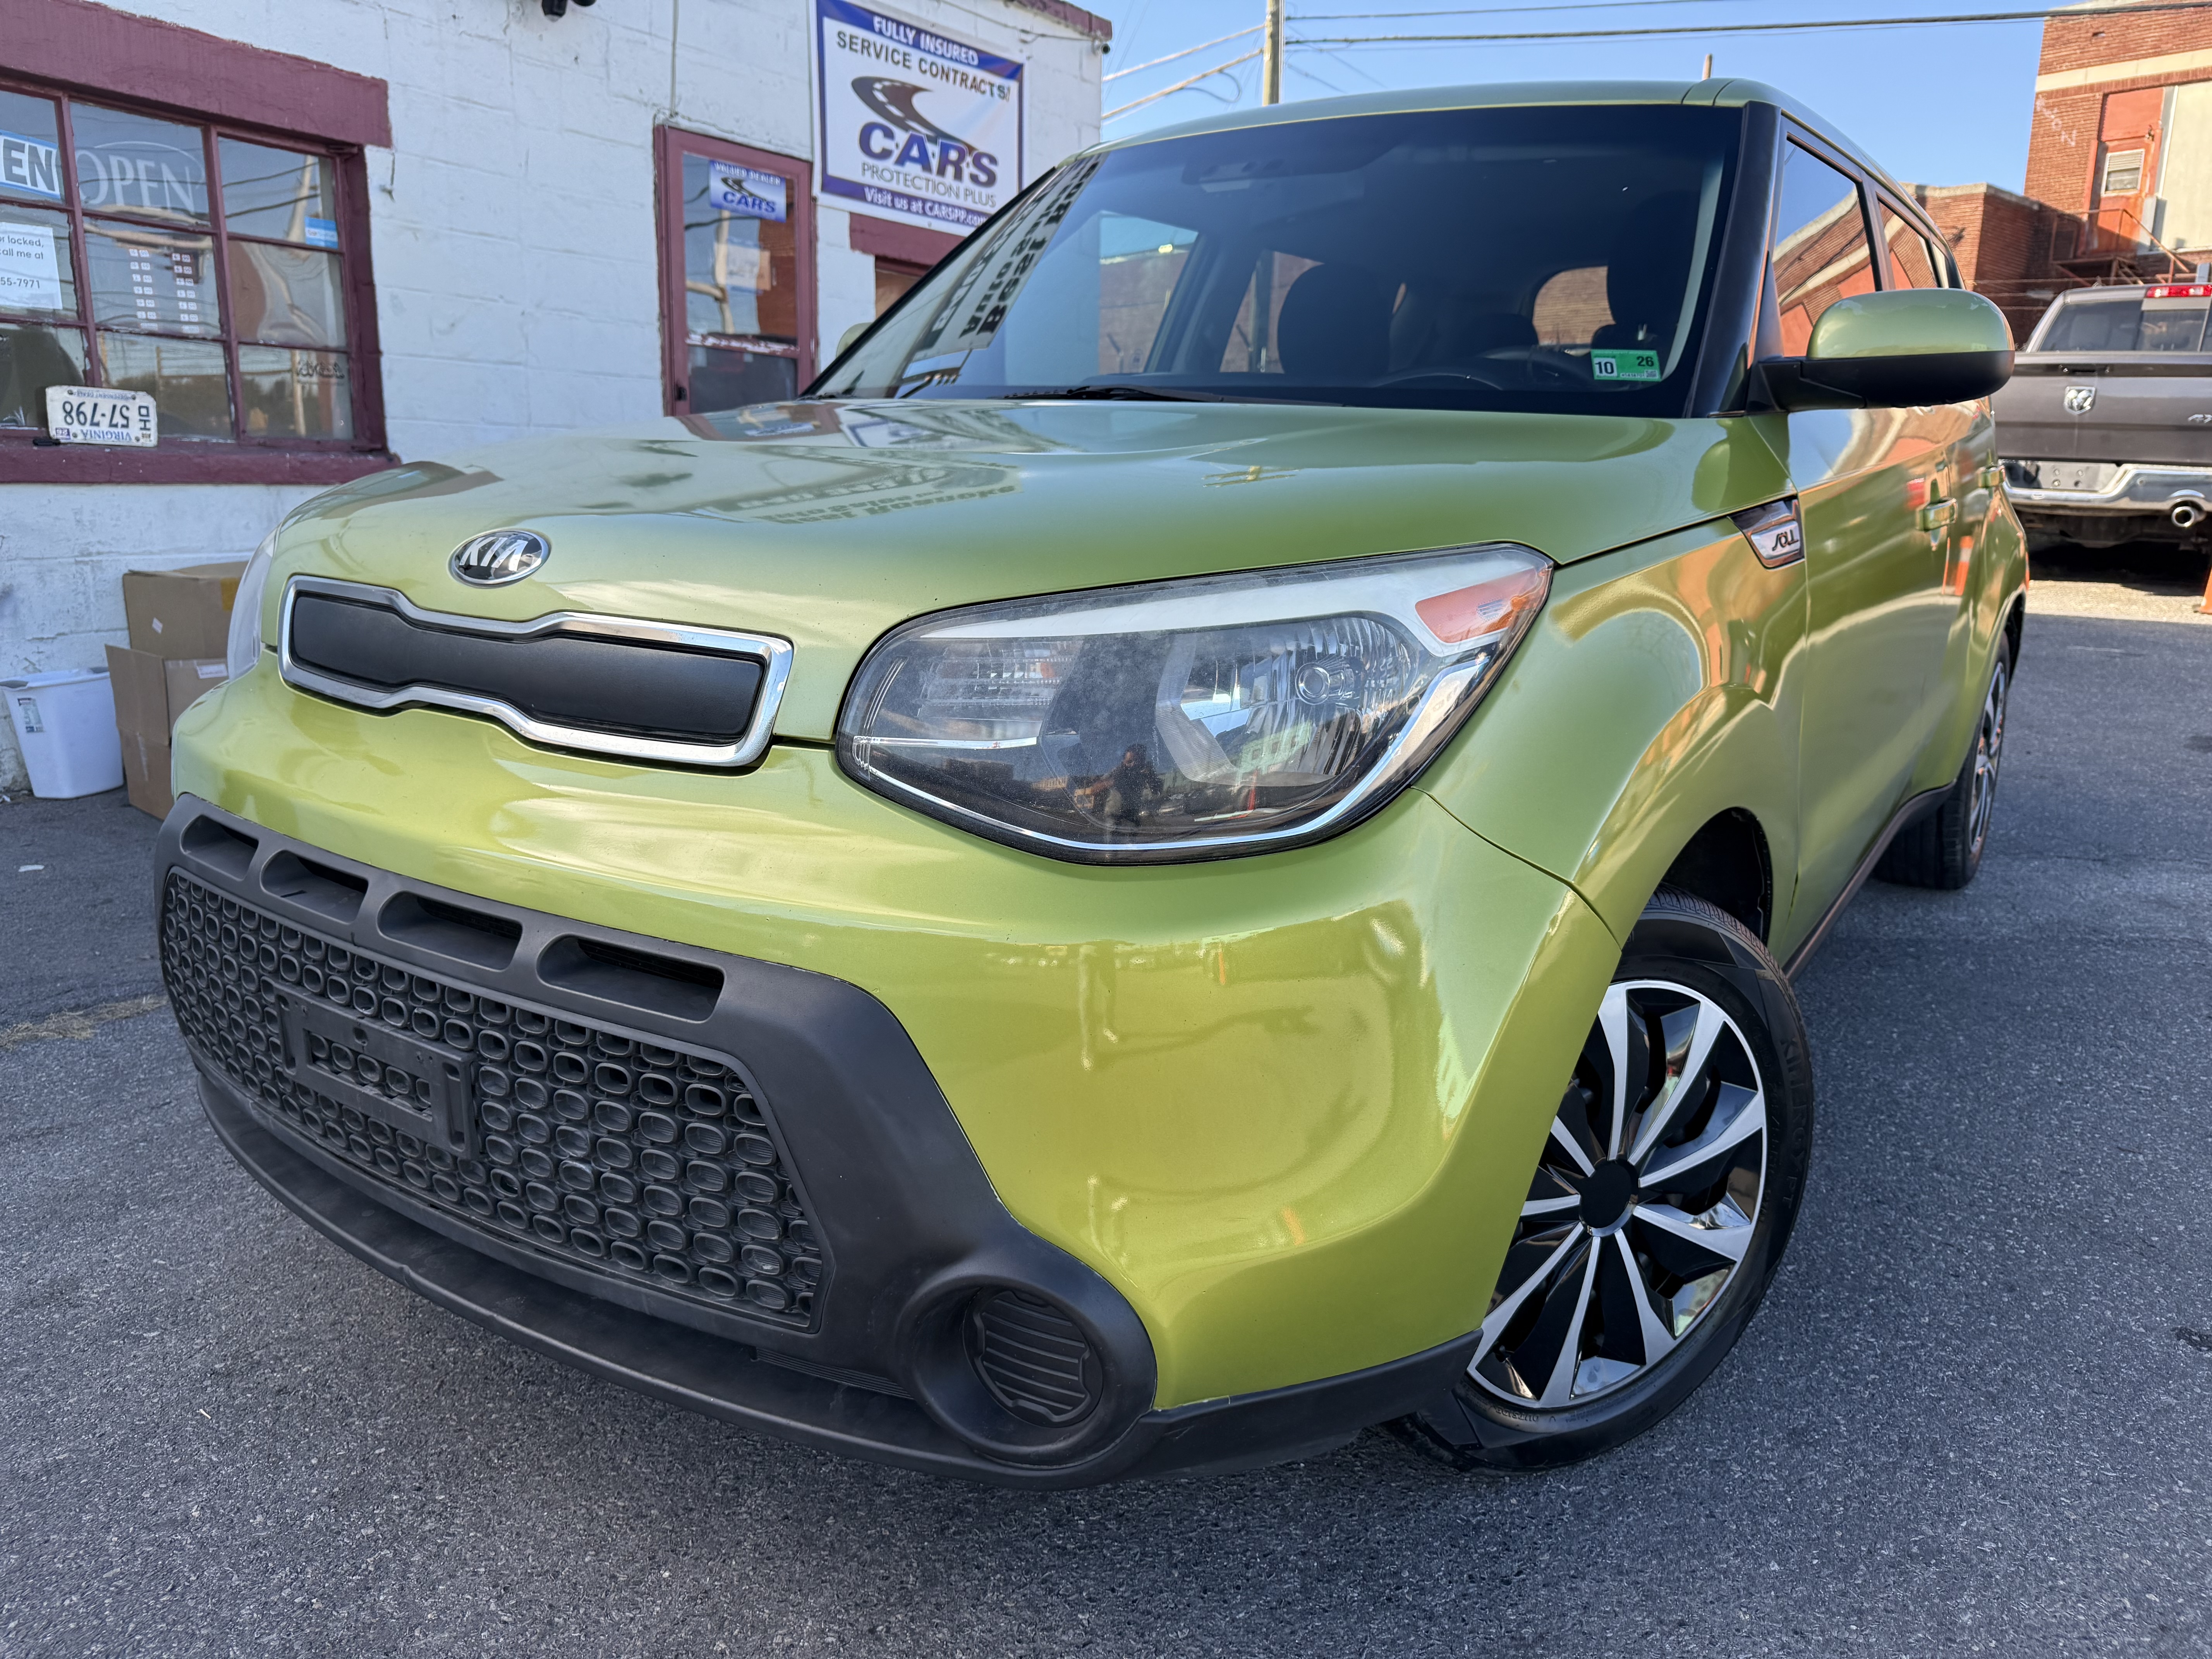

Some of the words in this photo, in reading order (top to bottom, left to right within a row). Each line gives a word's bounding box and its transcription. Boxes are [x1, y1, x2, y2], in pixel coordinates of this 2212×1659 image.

[873, 15, 917, 46] FULLY
[919, 33, 979, 66] INSURED
[836, 30, 912, 70] SERVICE
[918, 57, 1011, 102] CONTRACTS!
[75, 149, 195, 215] OPEN
[861, 161, 960, 199] PROTECTION
[963, 187, 996, 208] PLUS
[864, 186, 893, 207] Visit
[894, 196, 909, 210] us
[910, 199, 924, 214] at
[8, 235, 44, 248] locked,
[16, 250, 31, 258] me
[34, 251, 44, 259] at
[1595, 361, 1614, 374] 10
[1636, 356, 1654, 367] 26
[62, 401, 130, 428] 57-798
[80, 429, 132, 442] VIRGINIA
[459, 536, 529, 572] KIA
